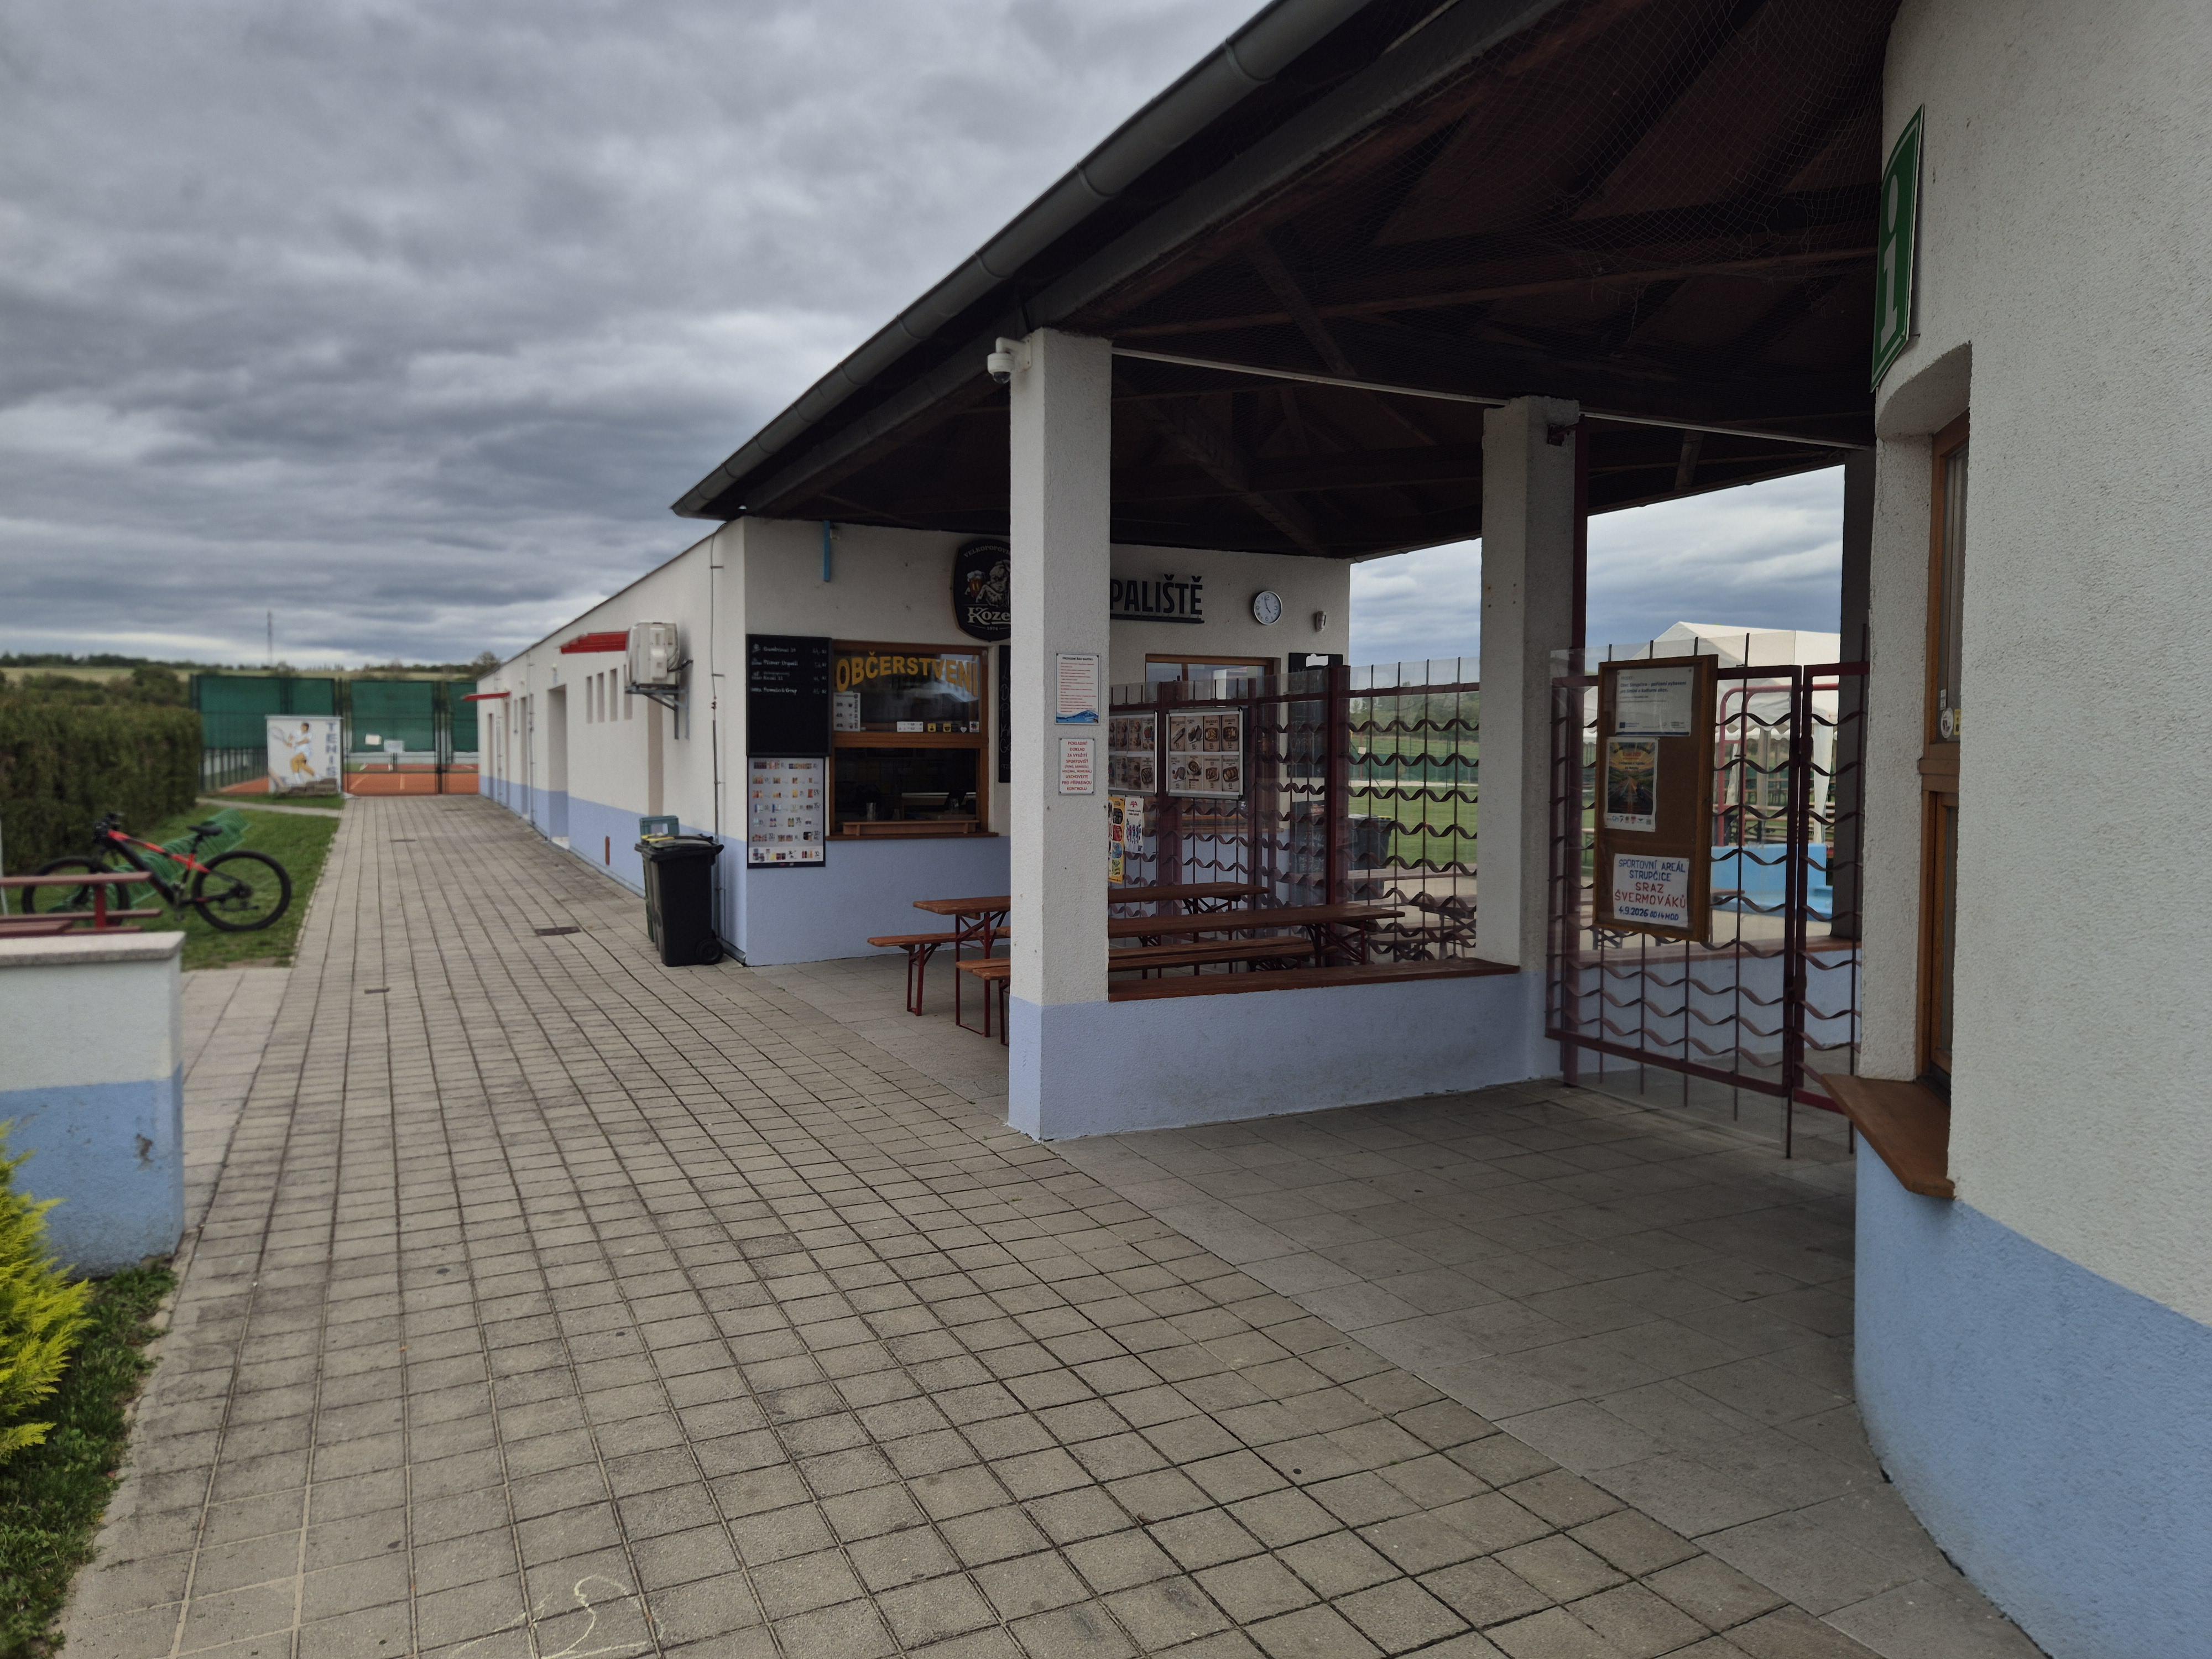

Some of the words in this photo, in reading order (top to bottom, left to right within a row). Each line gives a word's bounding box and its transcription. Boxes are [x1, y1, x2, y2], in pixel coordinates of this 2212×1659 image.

[964, 545, 1010, 558] VELKOPOPOVI
[1110, 573, 1203, 615] PALIŠTĚ
[967, 607, 1010, 625] Koze
[836, 651, 979, 698] OBČERSTVENÍ
[1619, 859, 1657, 870] SPORTOVNÍ
[1661, 861, 1686, 873] AREÁL
[1629, 870, 1672, 881] STRUPČICE
[1635, 881, 1664, 894] SRAZ
[1615, 889, 1686, 908] ŠVERMOVÁKŮ
